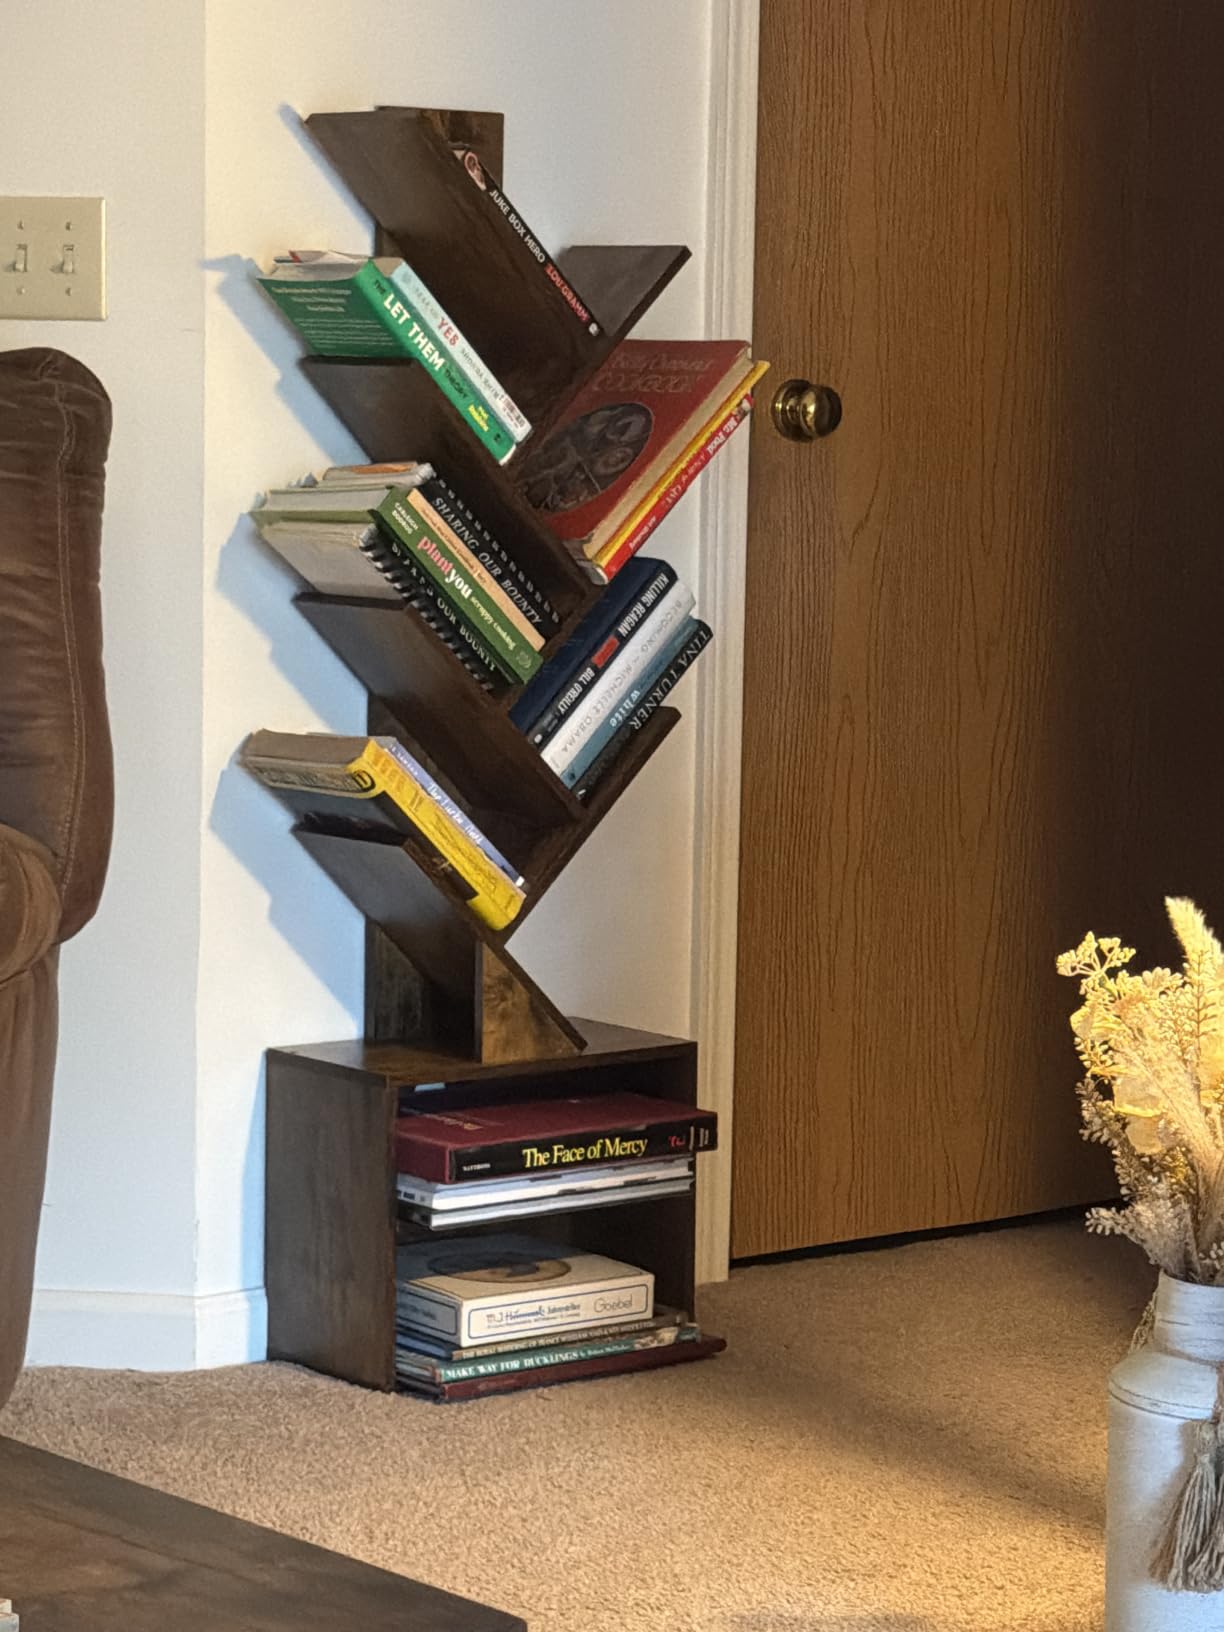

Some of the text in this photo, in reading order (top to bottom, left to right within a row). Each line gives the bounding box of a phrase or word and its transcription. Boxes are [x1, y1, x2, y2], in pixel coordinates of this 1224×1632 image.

[489, 190, 545, 263] JUKE BOX HERO
[384, 294, 411, 324] LET
[408, 323, 445, 371] THEM
[437, 317, 459, 346] YES
[432, 497, 480, 550] SHARING
[478, 551, 502, 578] OUR
[501, 579, 543, 624] BOUNTY
[470, 597, 516, 650] scrappy cooking
[618, 573, 670, 638] KILLING REAGAN
[641, 600, 683, 654] BECOMING
[460, 625, 495, 671] BOUNTY
[676, 630, 710, 667] TINA
[558, 667, 595, 715] BILL O'REILLY
[593, 664, 633, 715] MICHELLE
[609, 690, 640, 728] white
[628, 667, 680, 730] TURNER
[562, 716, 594, 753] OBAMA
[522, 1147, 550, 1168] The
[551, 1145, 584, 1166] Face
[587, 1139, 602, 1158] of
[603, 1136, 648, 1159] Mercy
[593, 1294, 633, 1313] Goebel
[446, 1366, 474, 1379] MAKE
[477, 1363, 497, 1374] WAY
[500, 1359, 520, 1370] FOR
[523, 1350, 579, 1367] DUCKLINGS
